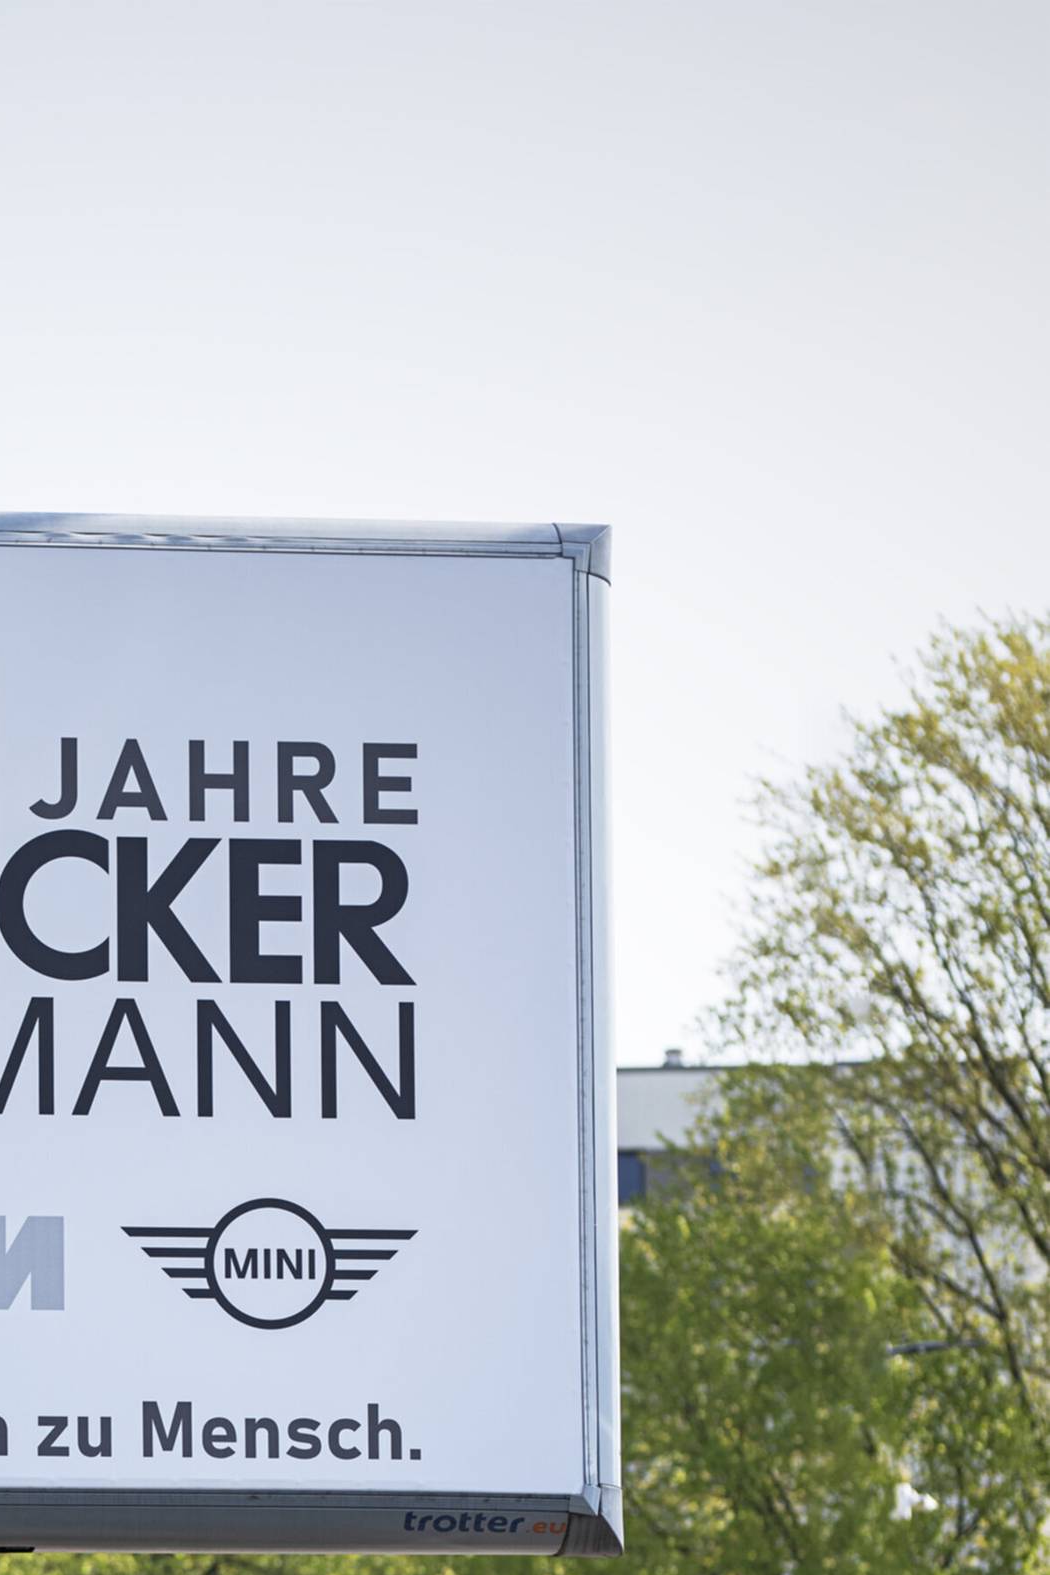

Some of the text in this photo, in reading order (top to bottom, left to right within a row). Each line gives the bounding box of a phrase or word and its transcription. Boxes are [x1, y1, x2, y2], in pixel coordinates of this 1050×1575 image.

[28, 736, 419, 825] JAHRE
[223, 1247, 317, 1281] MINI
[36, 1414, 113, 1458] zu
[141, 1399, 423, 1461] Mensch.
[403, 1510, 567, 1535] trotter.eu
